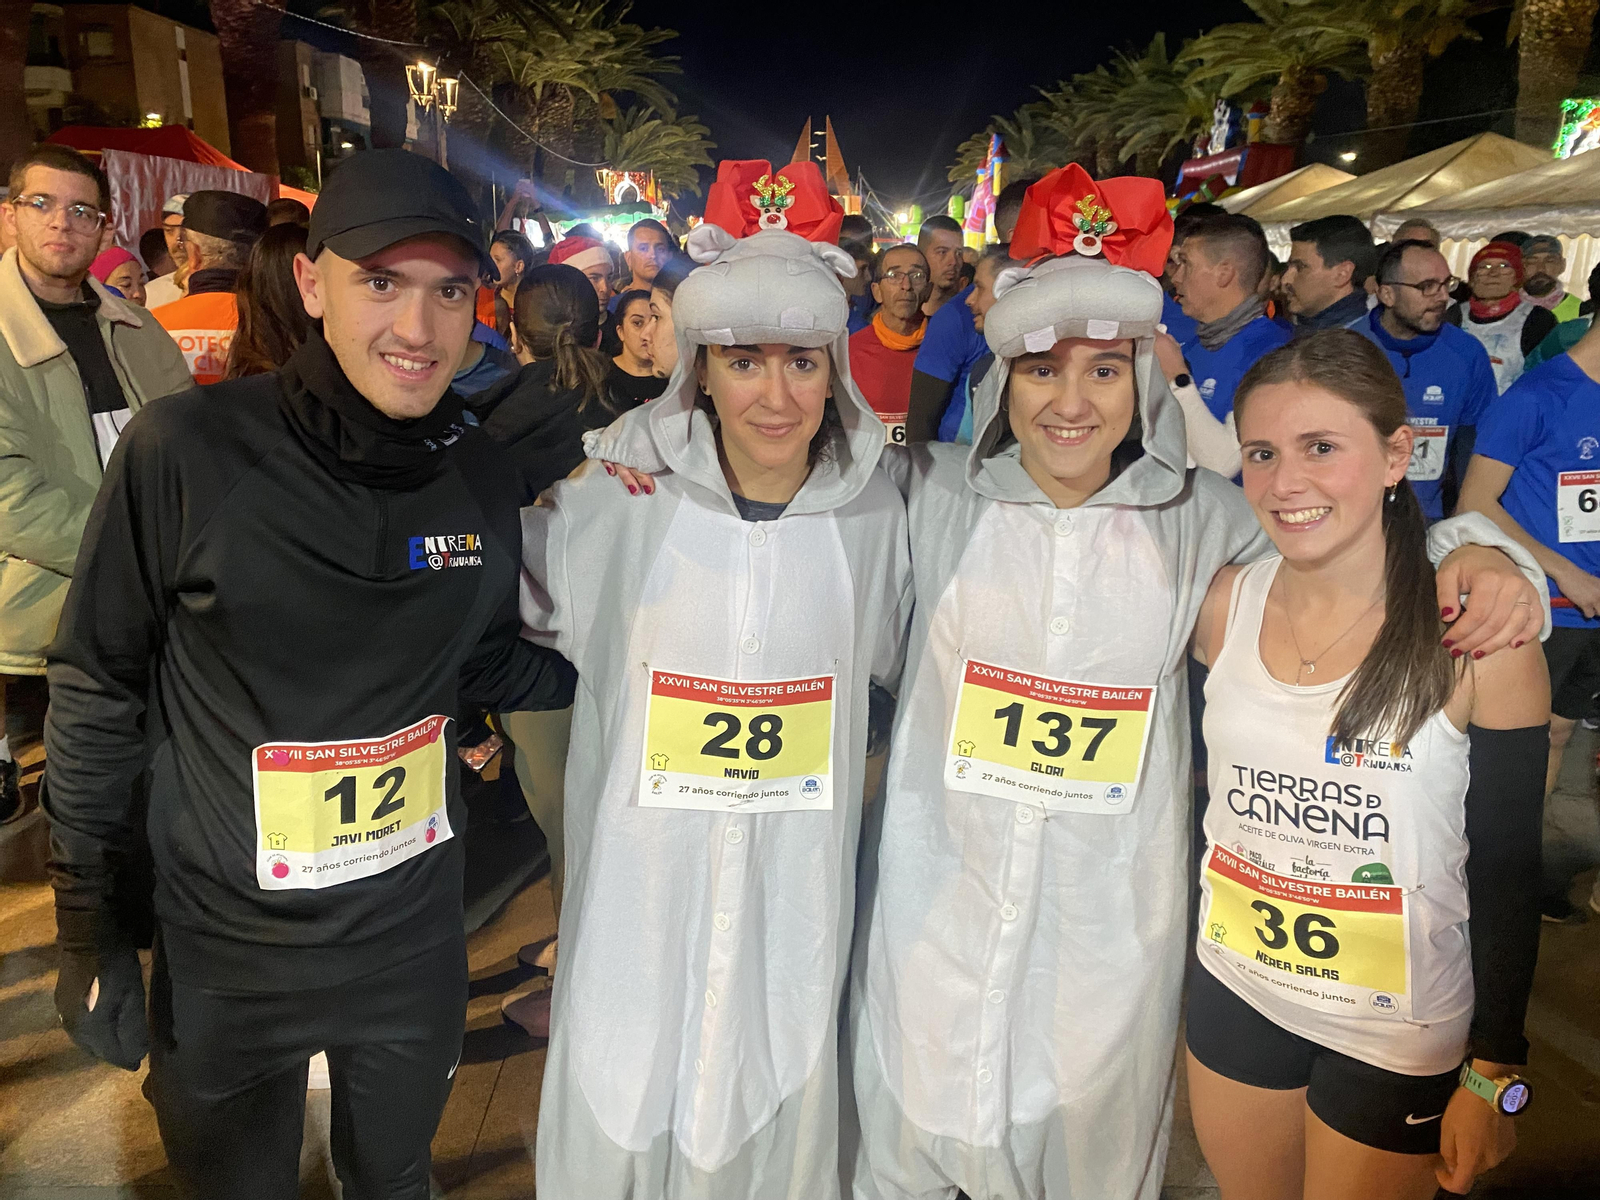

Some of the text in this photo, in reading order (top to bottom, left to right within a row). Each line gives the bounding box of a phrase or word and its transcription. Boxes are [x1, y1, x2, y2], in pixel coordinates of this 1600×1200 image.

[408, 534, 482, 570] ENTRENA
[428, 552, 483, 571] @TRIJUANSA
[658, 674, 825, 697] XXVII SAN SILVESTRE BAILÉN
[971, 664, 1143, 700] XXVII SAN SILVESTRE BAILÉN
[306, 748, 336, 761] SAN
[339, 737, 406, 758] SILVESTRE
[407, 719, 438, 743] BAILÉN
[700, 711, 783, 760] 28
[994, 701, 1118, 762] 137
[1030, 761, 1065, 777] GLORI
[1340, 753, 1413, 773] @TRIJUANSA
[324, 766, 407, 825] 12
[678, 785, 789, 800] 27 años corriendo juntos
[981, 773, 993, 781] 27
[994, 774, 1016, 787] años
[1018, 780, 1063, 798] corriendo
[1063, 789, 1094, 800] juntos
[331, 819, 402, 847] JAVI MORET
[1238, 822, 1375, 856] ACEITE DE OLIVA VIRGEN EXTRA
[301, 837, 417, 874] 27 años corriendo juntos
[1292, 862, 1330, 878] factoría
[1305, 854, 1315, 867] la
[1215, 850, 1238, 869] XXVII
[1238, 862, 1260, 880] SAN
[1261, 874, 1332, 898] SILVESTRE
[1335, 886, 1390, 901] BAILÉN
[1251, 899, 1340, 960] 36
[1255, 949, 1340, 981] NEREA SALAS
[1236, 961, 1357, 1005] 27 años corriendo juntos
